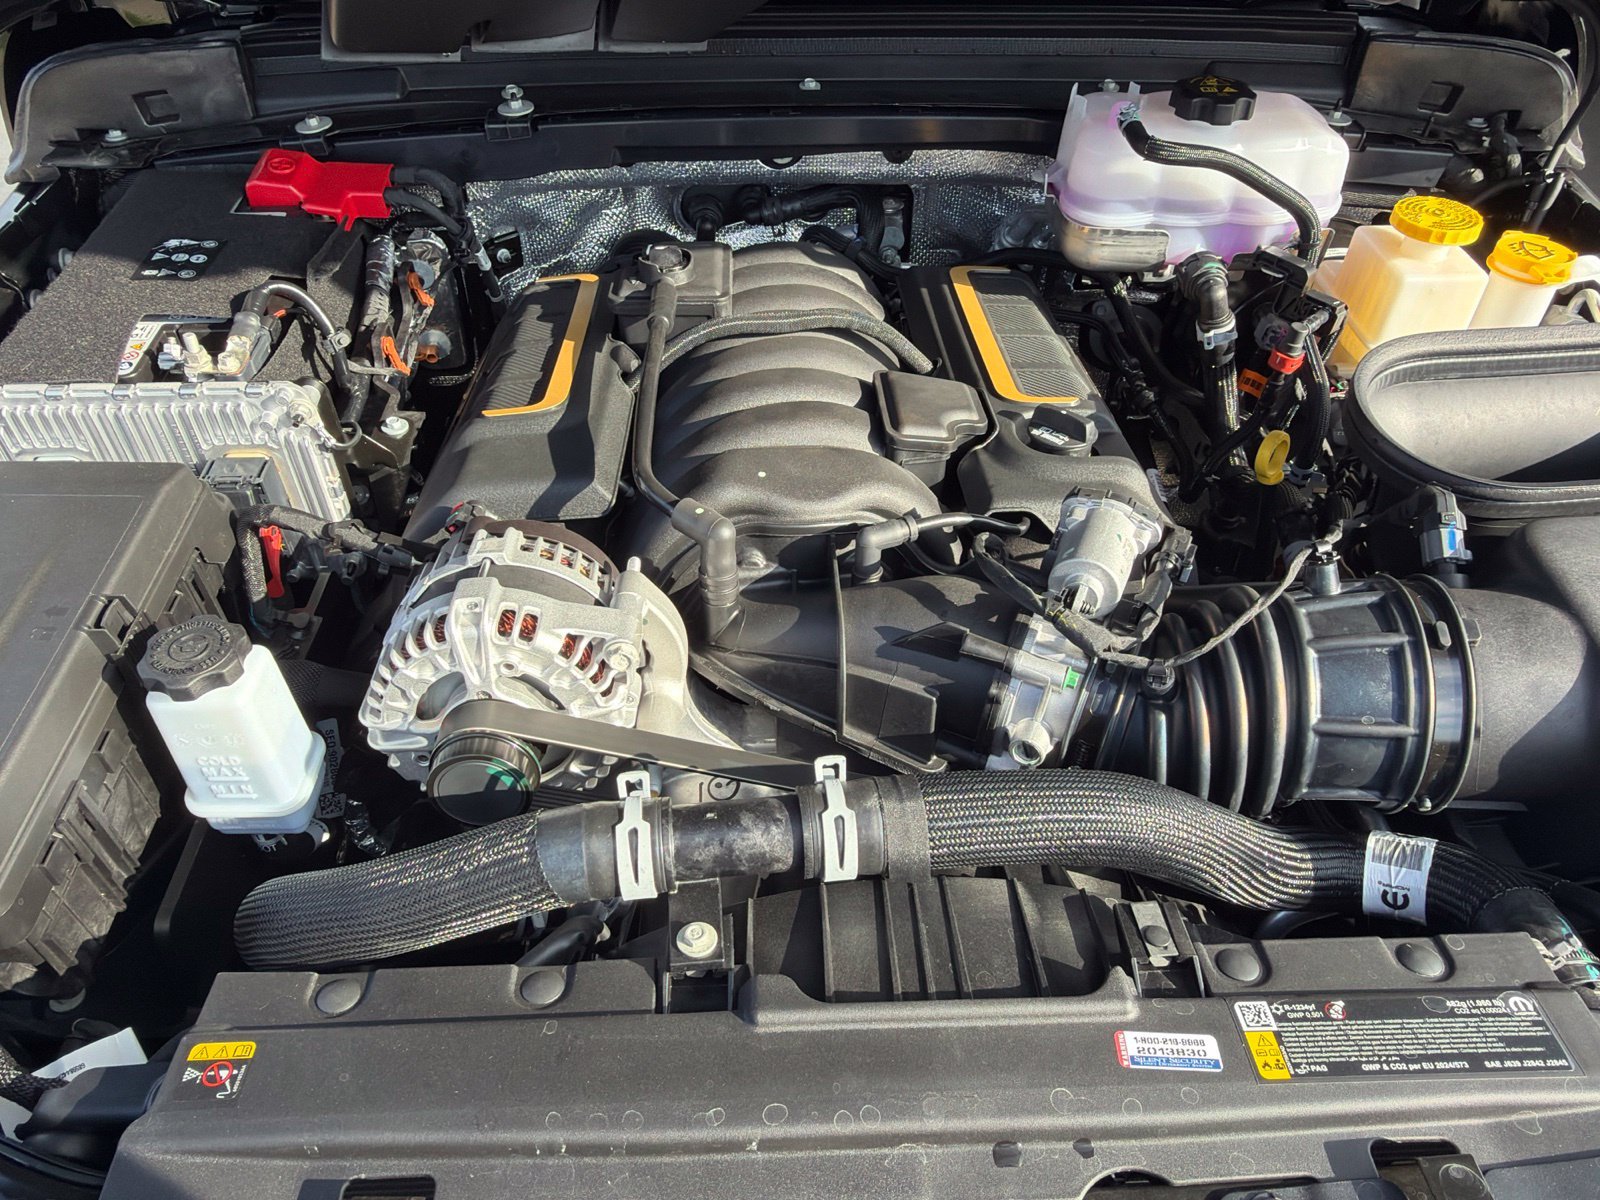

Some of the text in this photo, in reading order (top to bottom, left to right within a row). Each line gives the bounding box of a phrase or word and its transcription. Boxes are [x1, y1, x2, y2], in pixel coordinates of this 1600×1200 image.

[198, 756, 241, 766] COLD
[201, 767, 247, 777] MAX
[210, 784, 254, 794] MIN
[1136, 1046, 1207, 1057] 2013830
[1134, 1056, 1216, 1065] SILENT SECURITY
[1484, 1060, 1502, 1068] SAE
[1361, 1063, 1380, 1071] GWP
[1391, 1062, 1408, 1070] CO2
[1409, 1063, 1421, 1071] per
